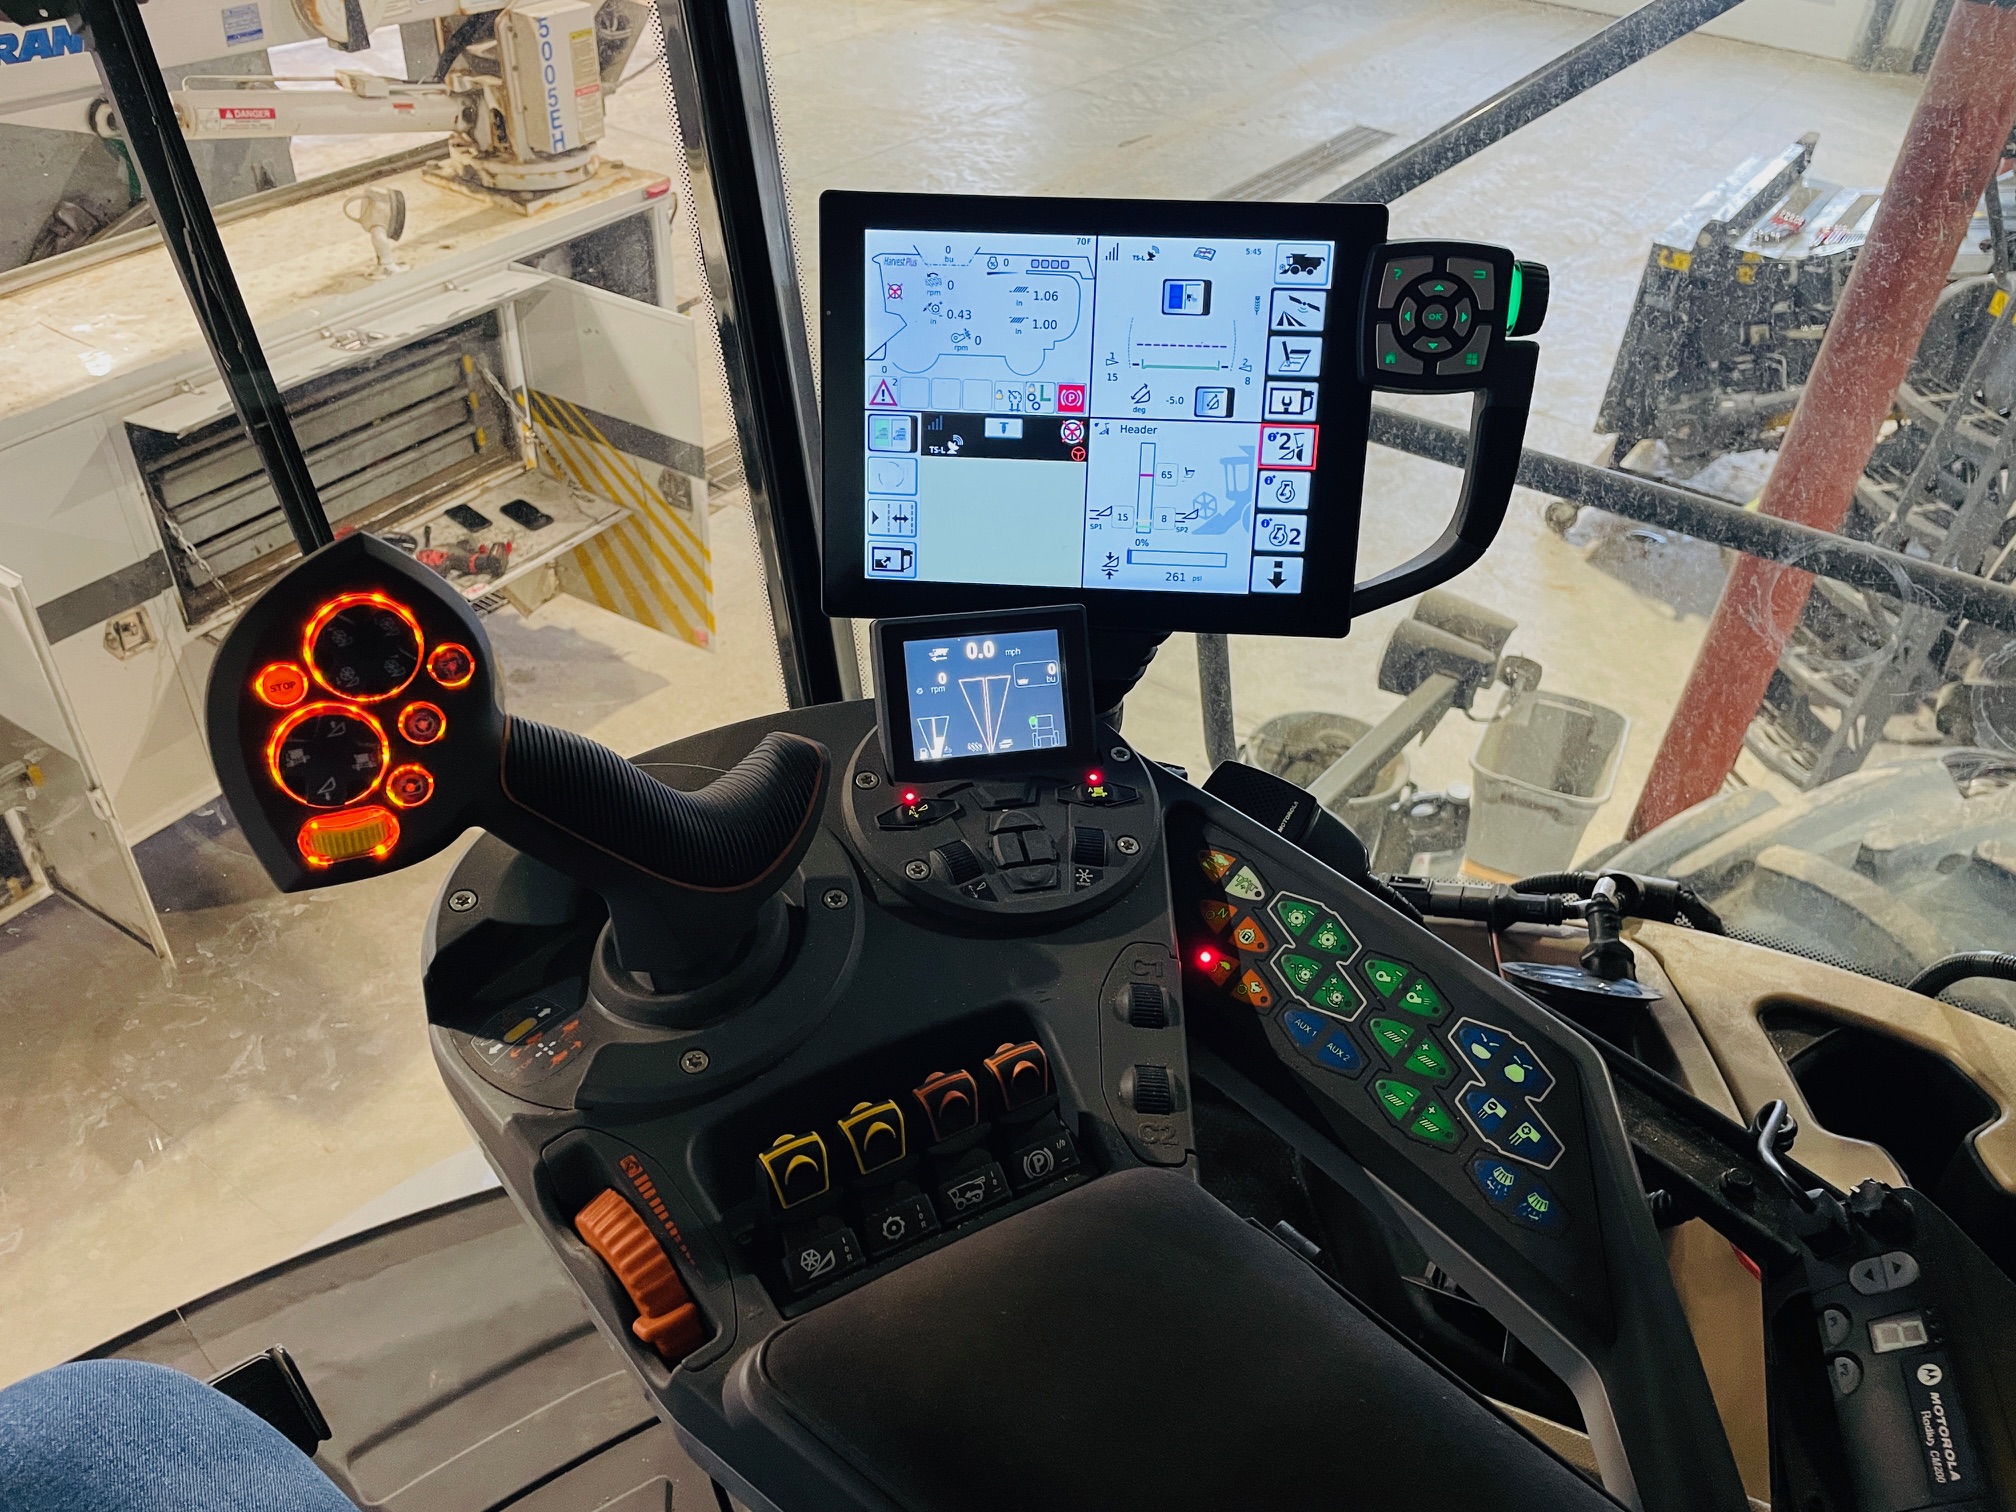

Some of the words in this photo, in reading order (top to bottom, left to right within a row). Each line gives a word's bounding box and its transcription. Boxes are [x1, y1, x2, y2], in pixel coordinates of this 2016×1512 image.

[234, 109, 271, 119] DANGER
[945, 245, 951, 254] 0
[1245, 247, 1262, 256] 5:45
[1003, 258, 1010, 267] 0
[947, 280, 954, 290] 0
[1033, 290, 1059, 301] 1.06
[946, 309, 972, 320] 0.43
[1428, 312, 1443, 321] OK
[1032, 319, 1058, 330] 1.00
[974, 335, 982, 346] 0
[881, 365, 888, 374] 0
[892, 378, 898, 387] 2
[1107, 373, 1118, 382] 15
[1244, 377, 1251, 385] 8
[1132, 405, 1146, 414] deg
[1119, 424, 1157, 435] Header
[1279, 432, 1291, 450] 2
[1160, 470, 1173, 479] 65
[1117, 513, 1128, 522] 15
[1161, 515, 1168, 524] 8
[1289, 528, 1301, 546] 2
[1134, 538, 1150, 548] 0%
[1165, 571, 1186, 582] 261
[965, 640, 995, 660] 0.0
[1005, 647, 1022, 657] mph
[1047, 662, 1057, 675] 0
[937, 671, 948, 685] 0
[1046, 675, 1057, 684] bu
[270, 681, 296, 692] STOP
[930, 685, 946, 695] rpm
[1277, 801, 1299, 833] MOTOROLA
[1293, 1018, 1311, 1033] AUX
[1326, 1041, 1343, 1057] AUX
[1929, 1392, 1962, 1482] MOTOROLA
[1929, 1450, 1947, 1484] CM200
